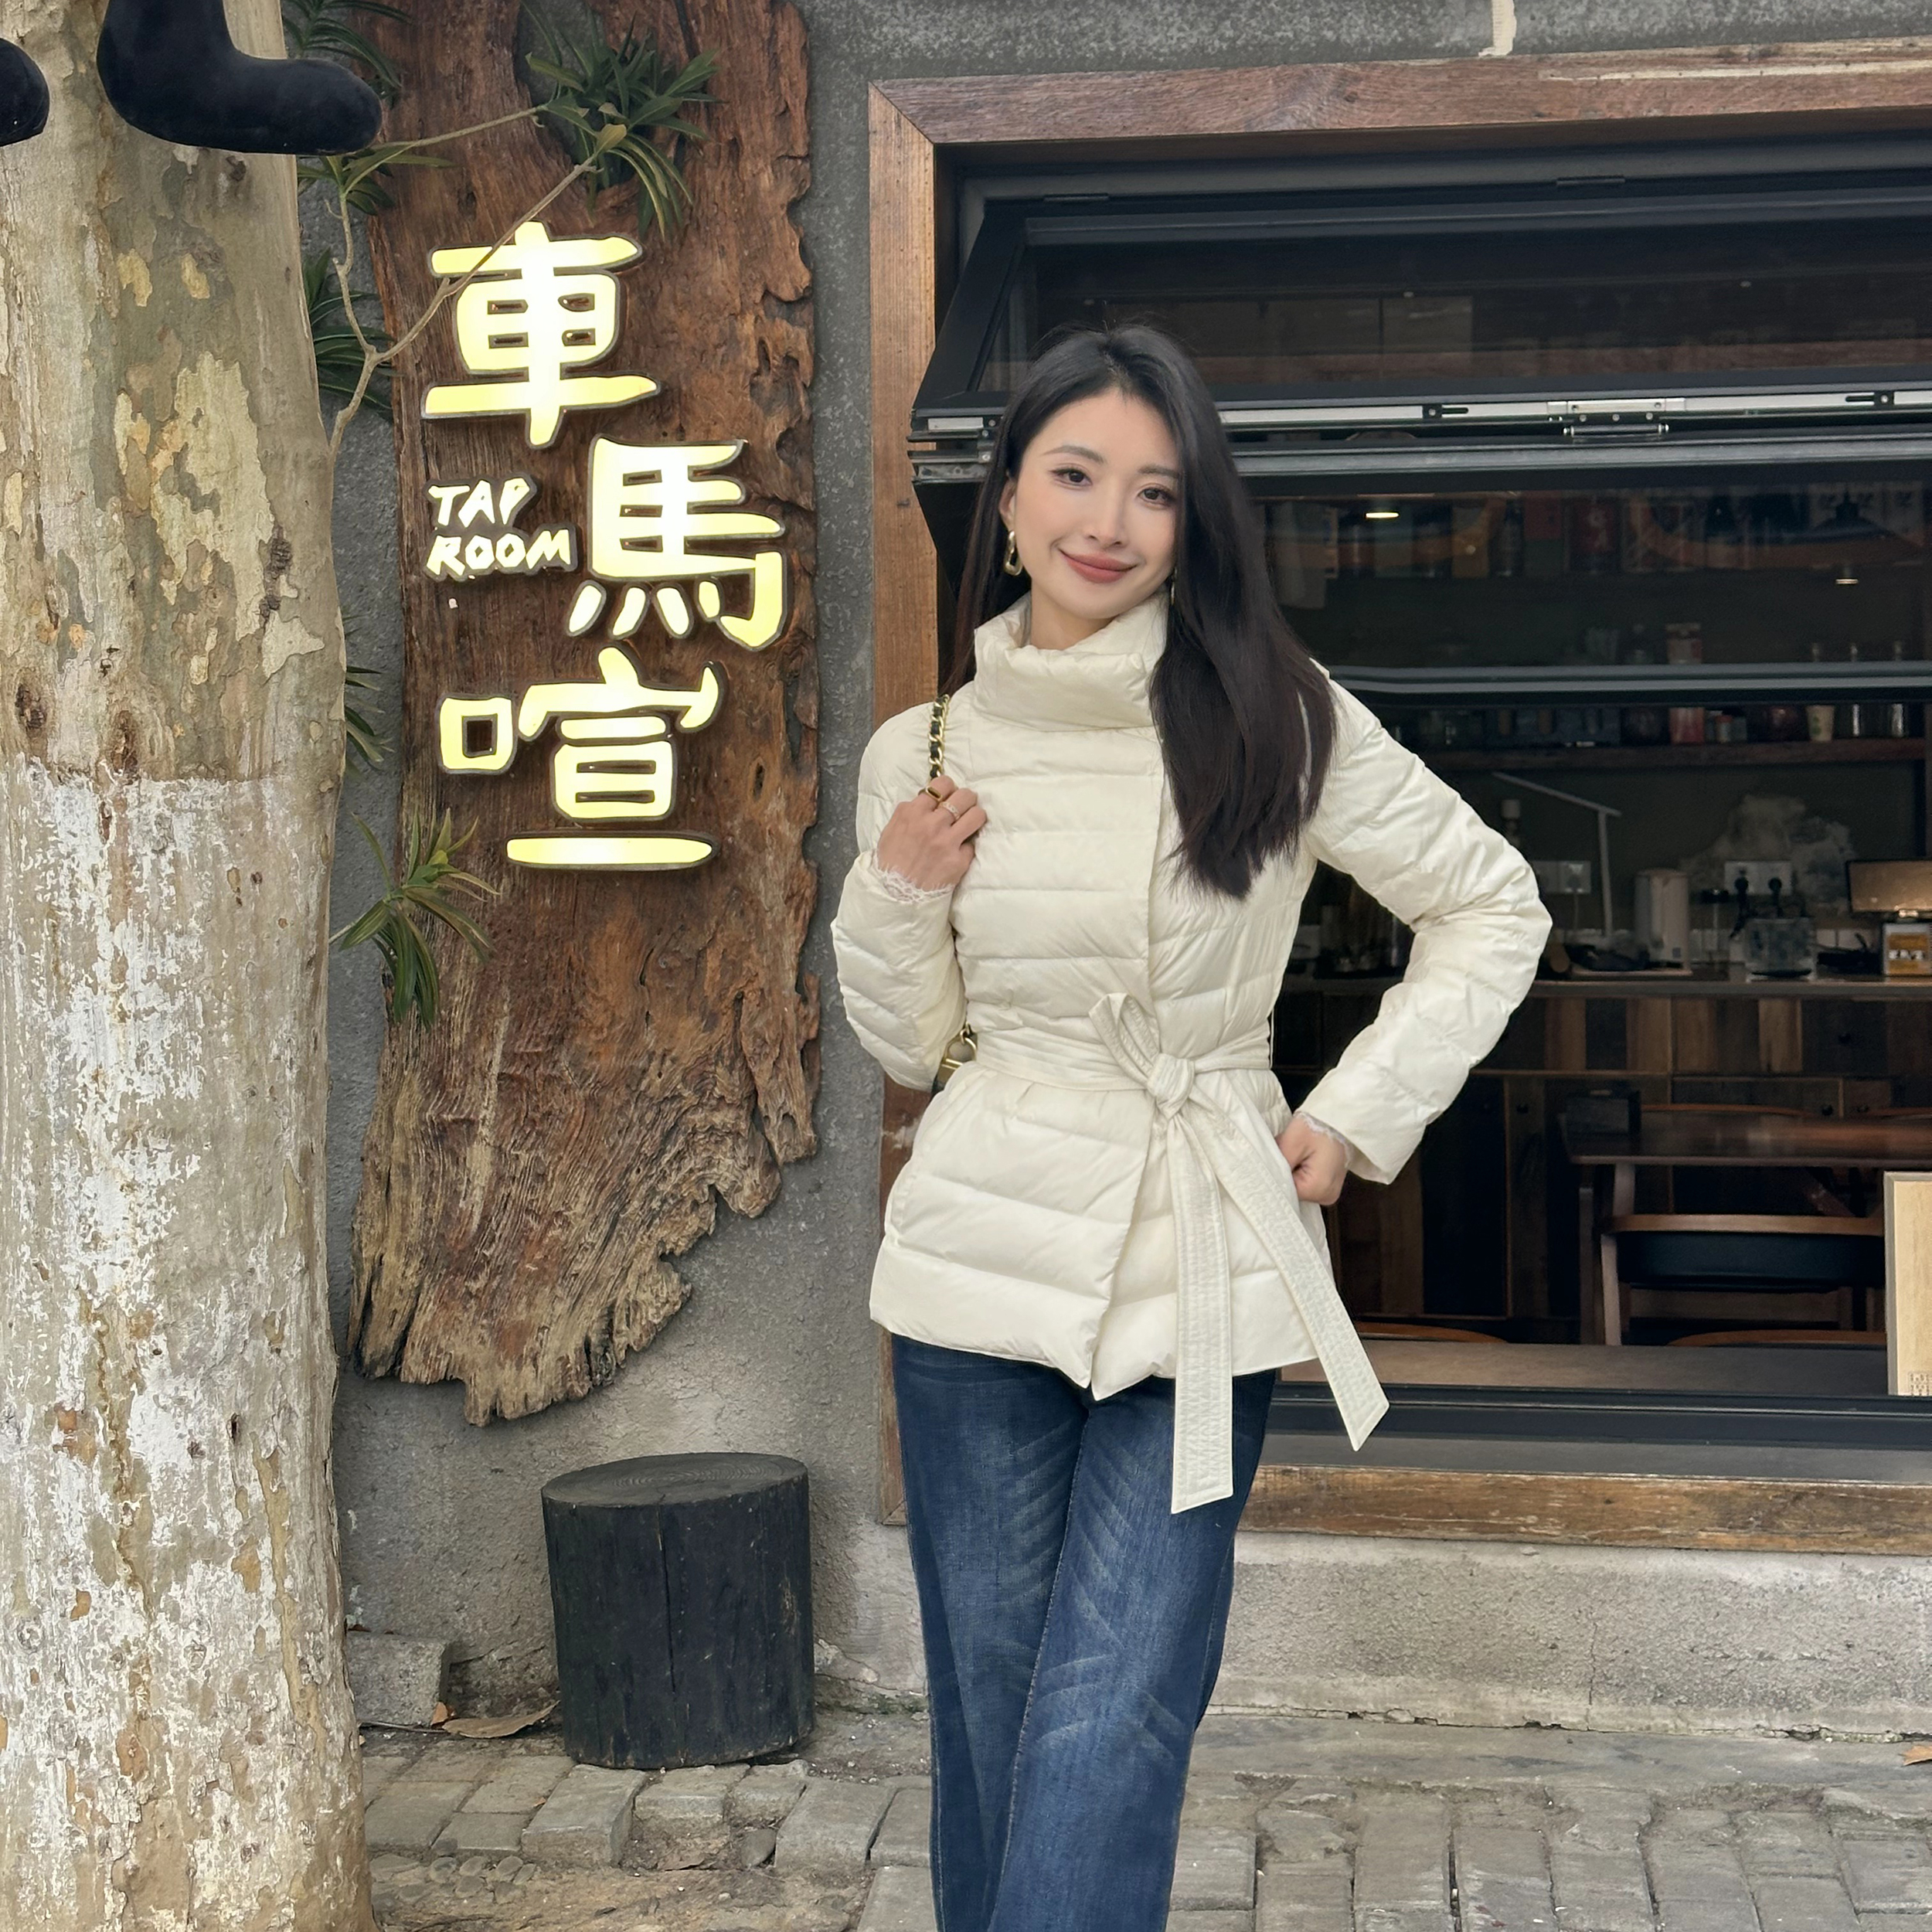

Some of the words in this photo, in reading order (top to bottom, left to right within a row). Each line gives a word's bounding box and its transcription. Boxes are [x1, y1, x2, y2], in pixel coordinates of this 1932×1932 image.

[427, 477, 531, 529] TAP
[424, 221, 784, 867] 車馬喧
[425, 529, 572, 577] ROOM
